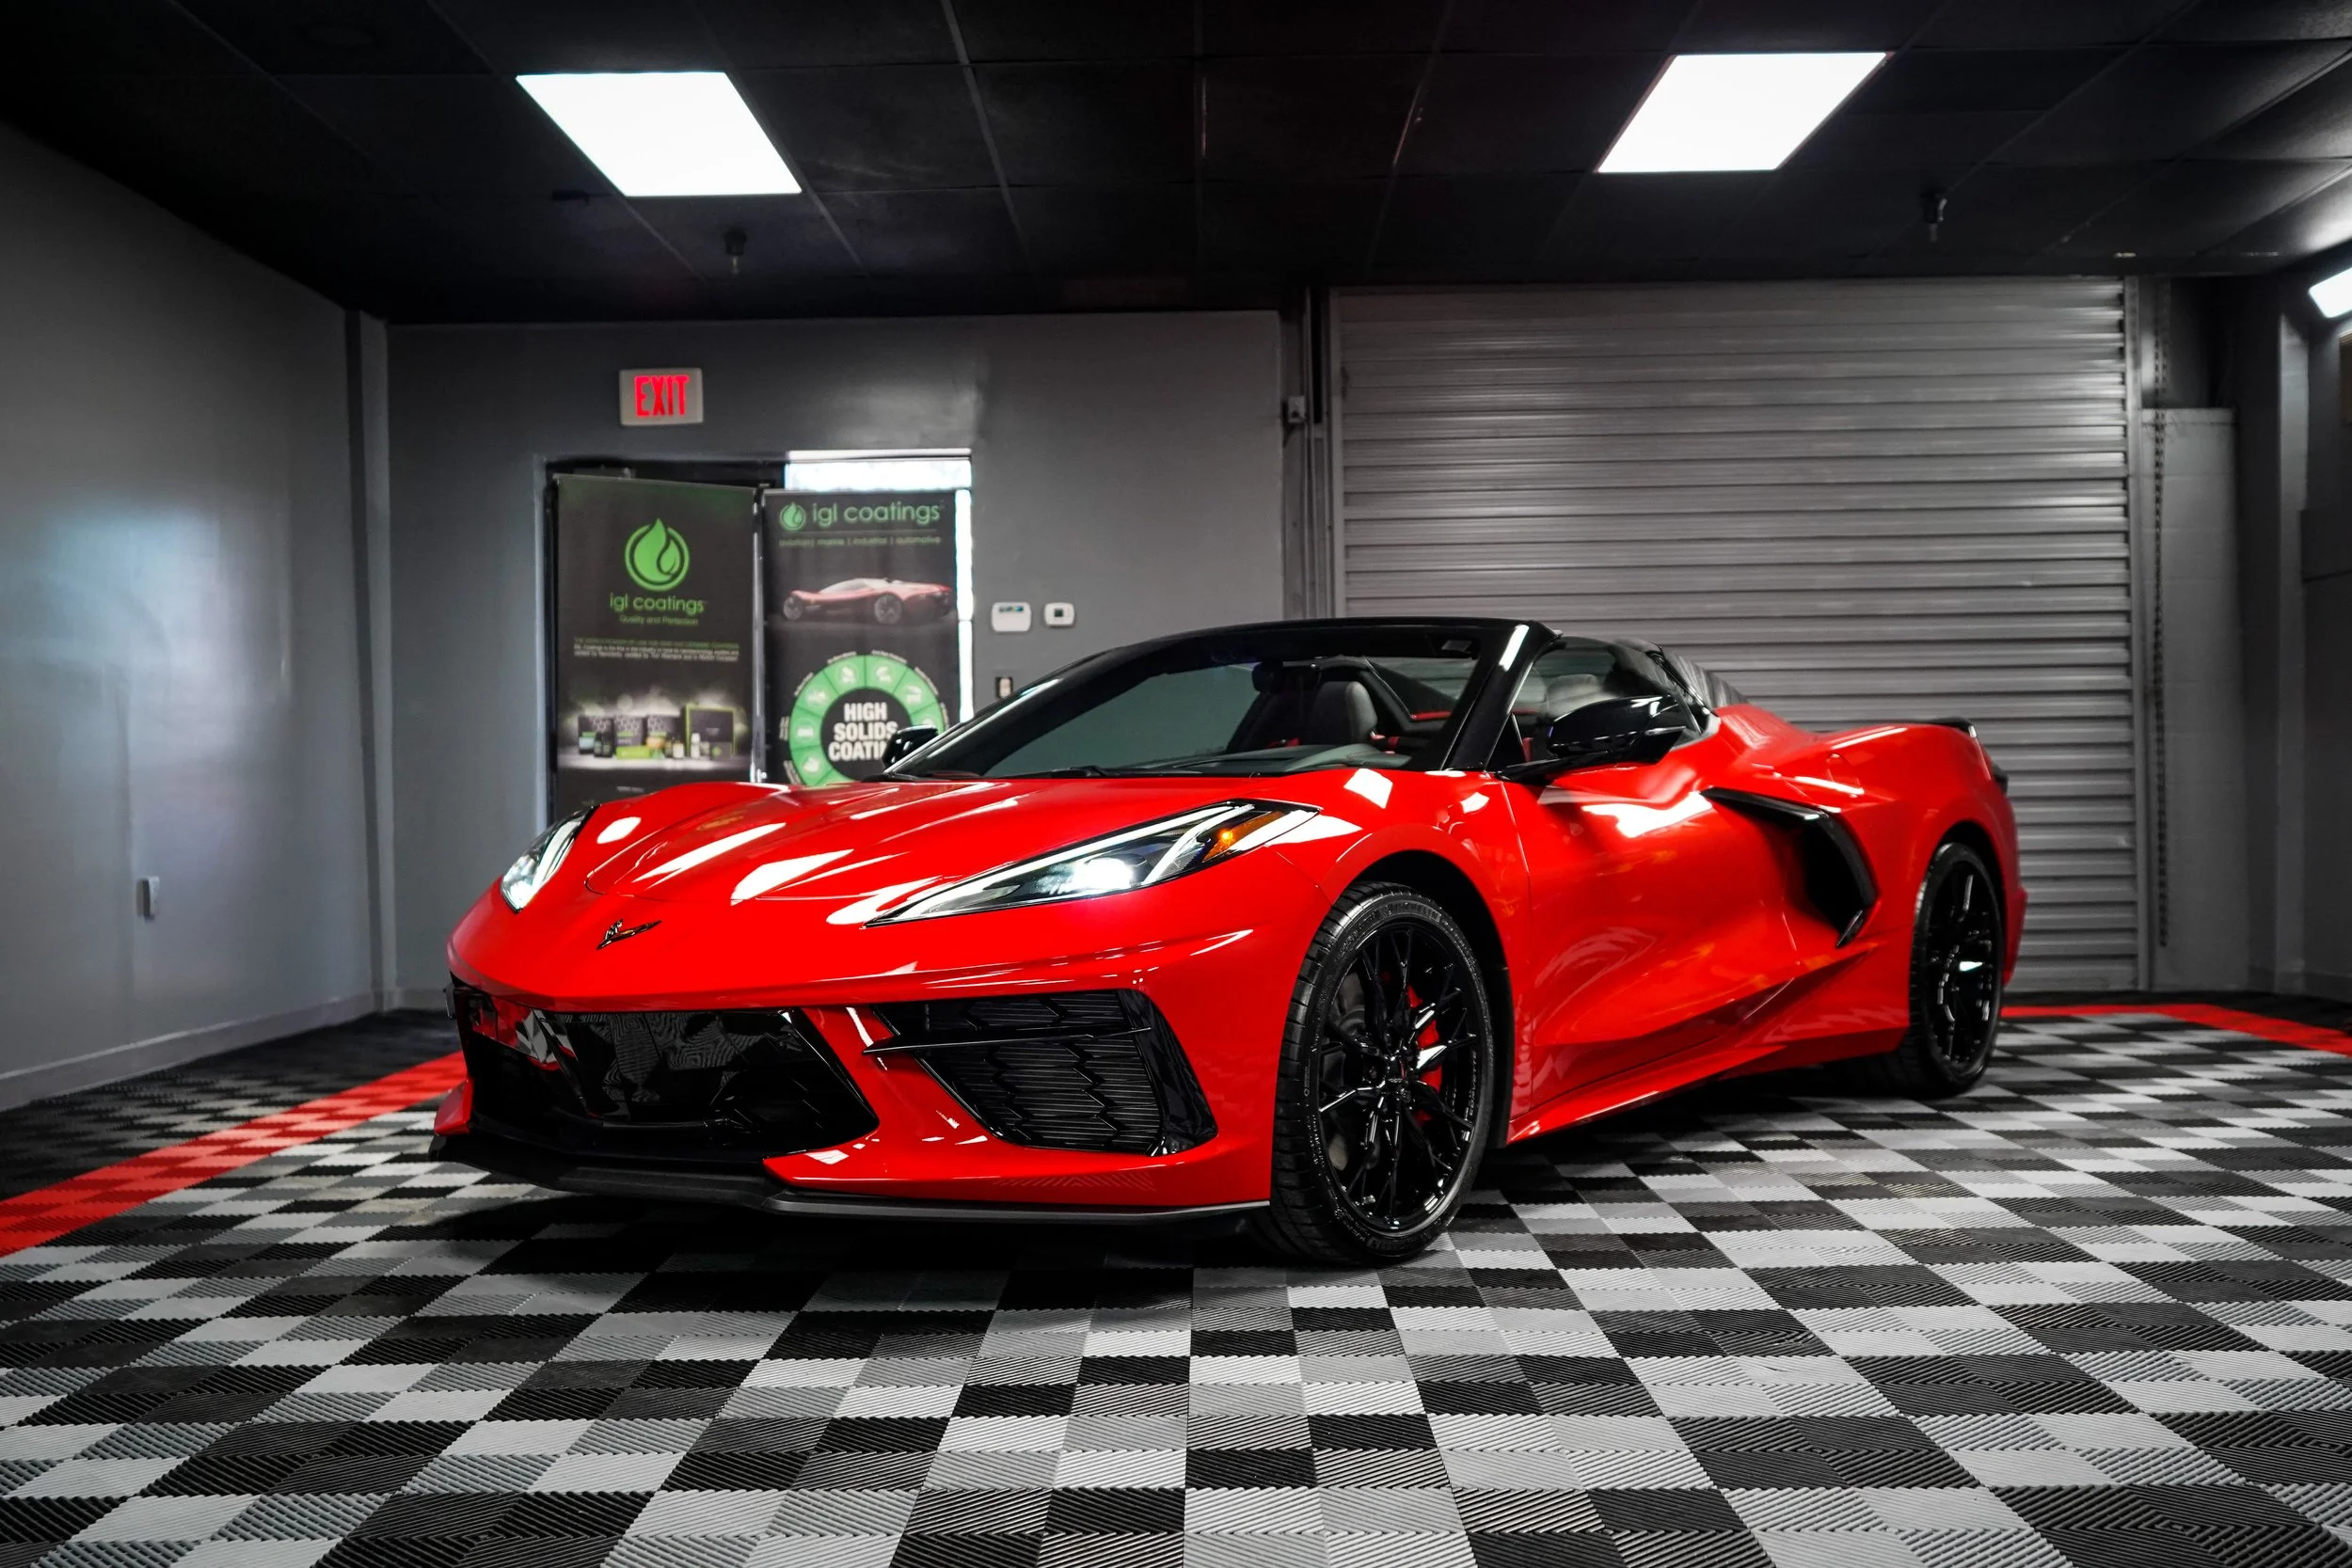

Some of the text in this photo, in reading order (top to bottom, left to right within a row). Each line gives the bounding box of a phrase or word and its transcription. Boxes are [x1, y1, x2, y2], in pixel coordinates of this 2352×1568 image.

[634, 374, 690, 417] EXIT
[812, 500, 940, 528] igl coatings
[610, 593, 704, 615] igl coatings
[843, 702, 888, 722] HIGH
[834, 721, 898, 743] SOLIDS
[828, 740, 887, 762] COATIN
